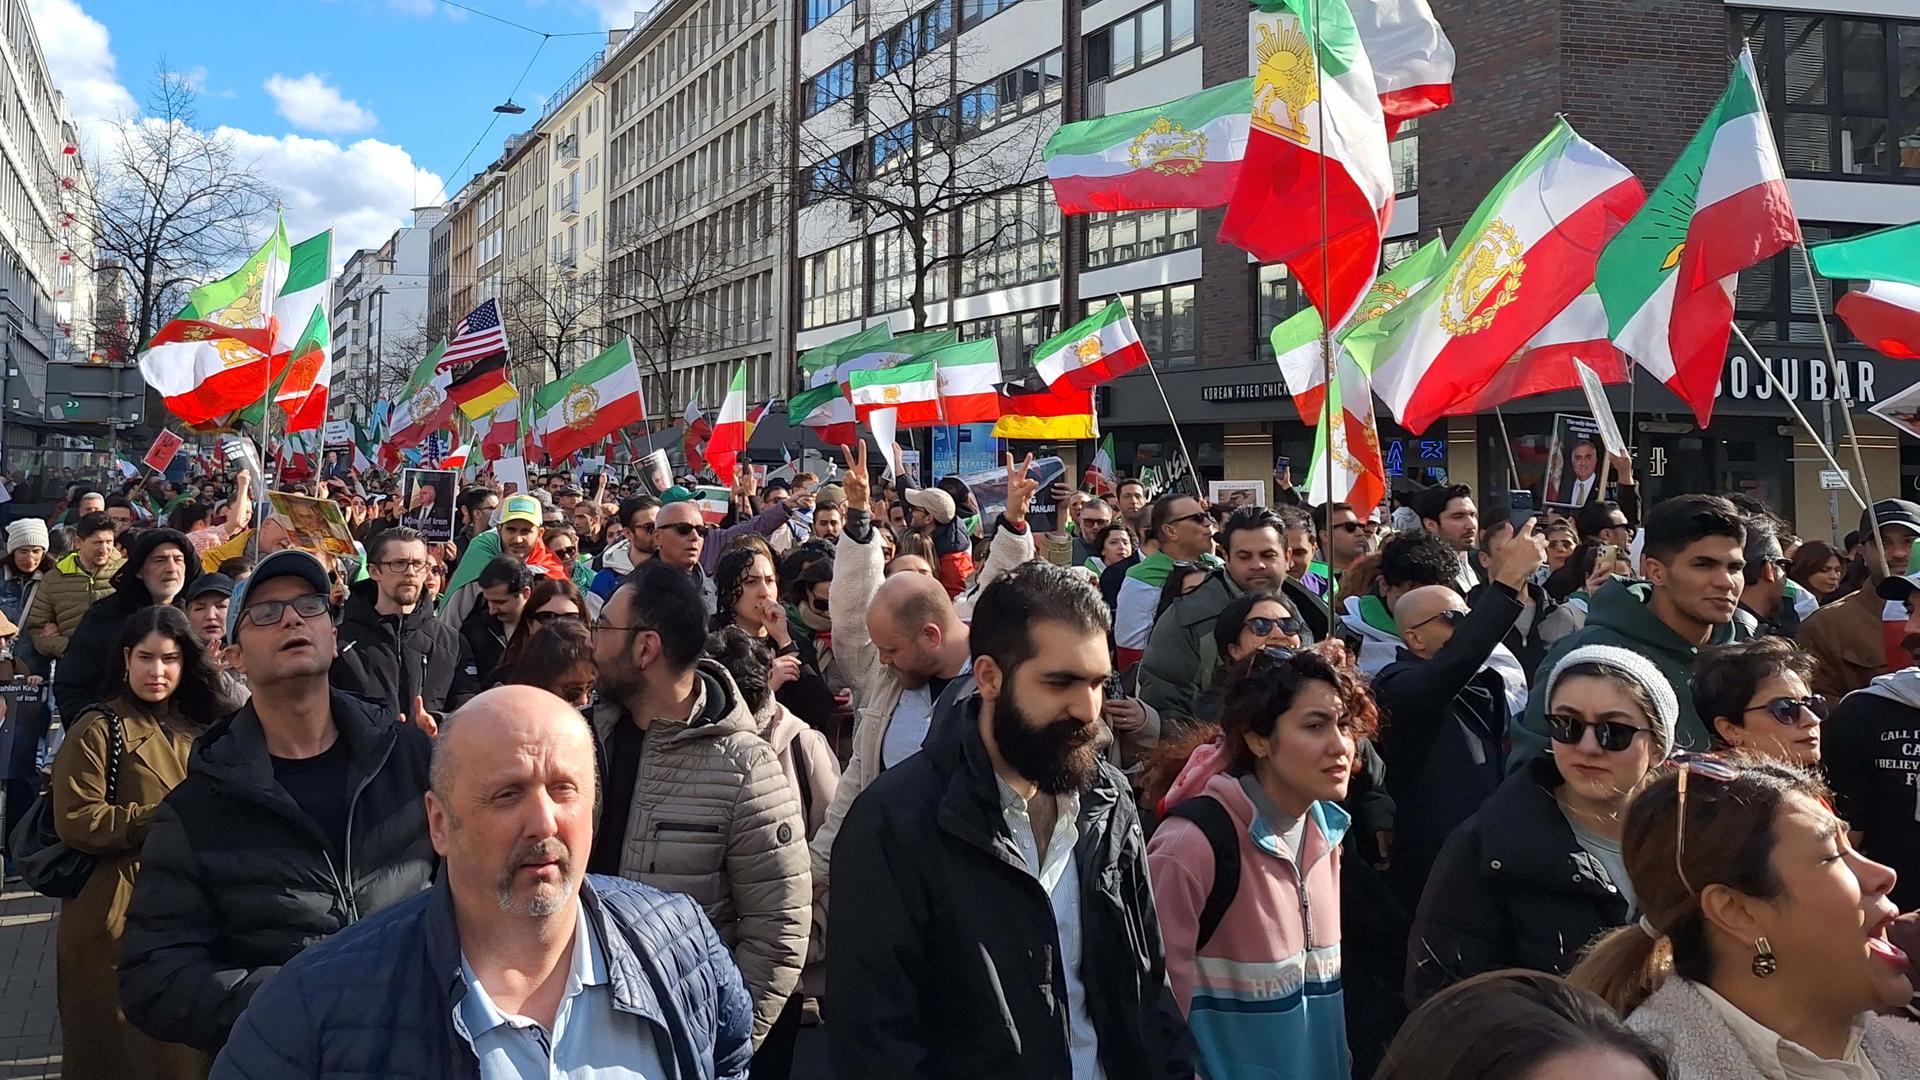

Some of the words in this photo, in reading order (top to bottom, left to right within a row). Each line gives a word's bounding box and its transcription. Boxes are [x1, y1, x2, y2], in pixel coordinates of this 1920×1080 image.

[1204, 387, 1233, 400] KOREAN
[1236, 385, 1260, 398] FRIED
[1031, 505, 1056, 513] PAHLAVI
[1881, 730, 1911, 741] CALL
